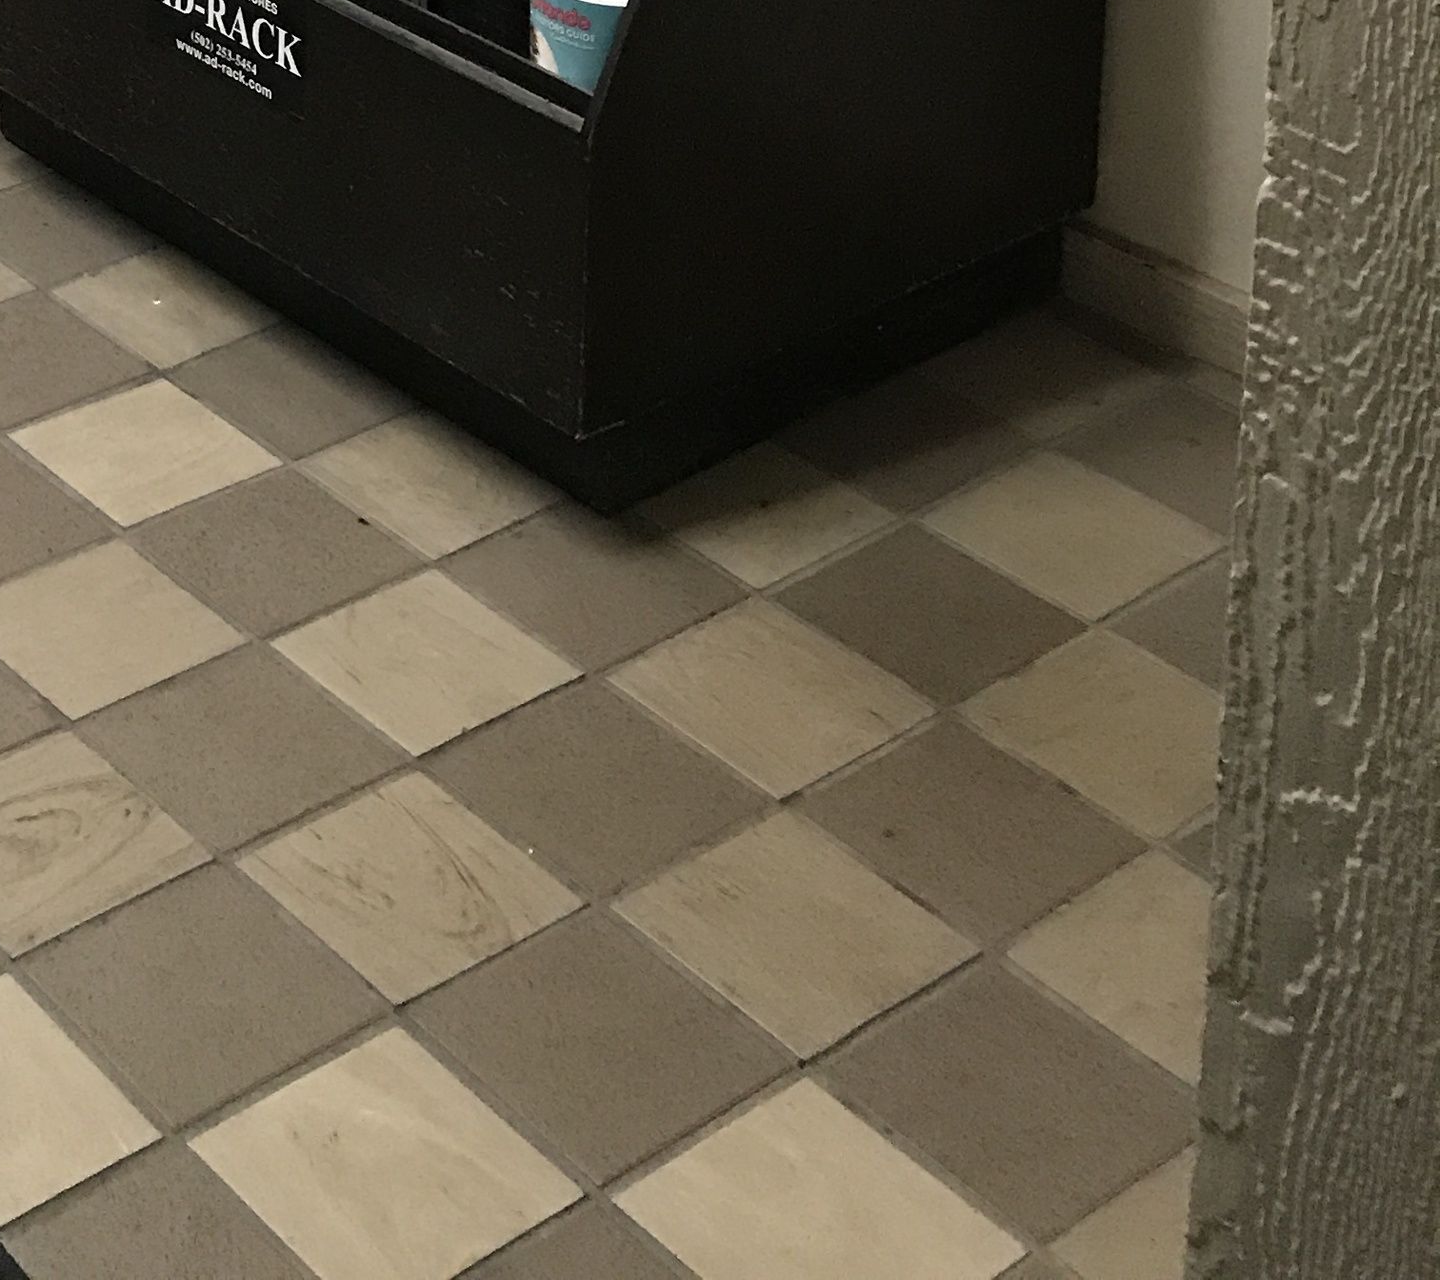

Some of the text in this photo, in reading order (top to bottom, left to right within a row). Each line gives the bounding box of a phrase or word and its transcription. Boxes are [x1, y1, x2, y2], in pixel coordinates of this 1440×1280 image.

[190, 29, 257, 76] (502) 253-5454
[566, 29, 595, 42] GUIDE
[175, 38, 272, 100] www.ad-rack.com
